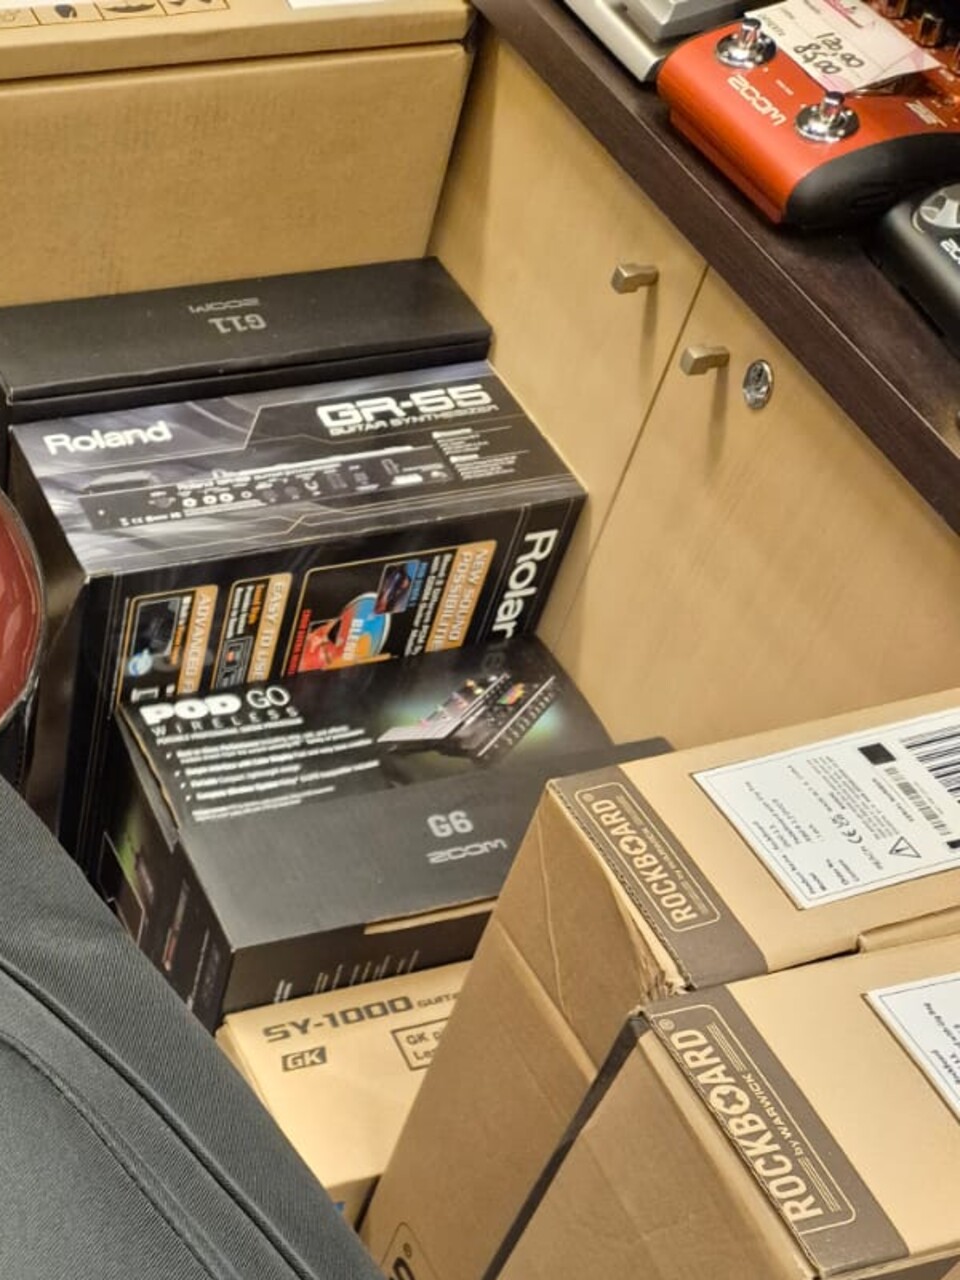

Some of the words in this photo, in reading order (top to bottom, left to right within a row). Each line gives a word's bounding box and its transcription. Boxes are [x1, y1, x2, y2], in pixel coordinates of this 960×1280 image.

[727, 73, 787, 126] ZOOM
[208, 313, 267, 334] G11
[316, 384, 493, 428] GR-55
[329, 421, 389, 437] GUITAR
[390, 404, 500, 427] SYNTHESIZER
[43, 421, 173, 455] Roland
[140, 693, 242, 726] POD
[246, 686, 290, 709] GO
[151, 706, 300, 737] WIRELESS
[427, 810, 474, 838] G6
[426, 838, 508, 864] ZOOM
[591, 799, 698, 924] ROCKBOARD
[262, 995, 414, 1044] SY-1000
[288, 1048, 323, 1068] GK
[742, 1072, 792, 1140] WARWICK
[670, 1029, 824, 1222] ROCKBOARD
